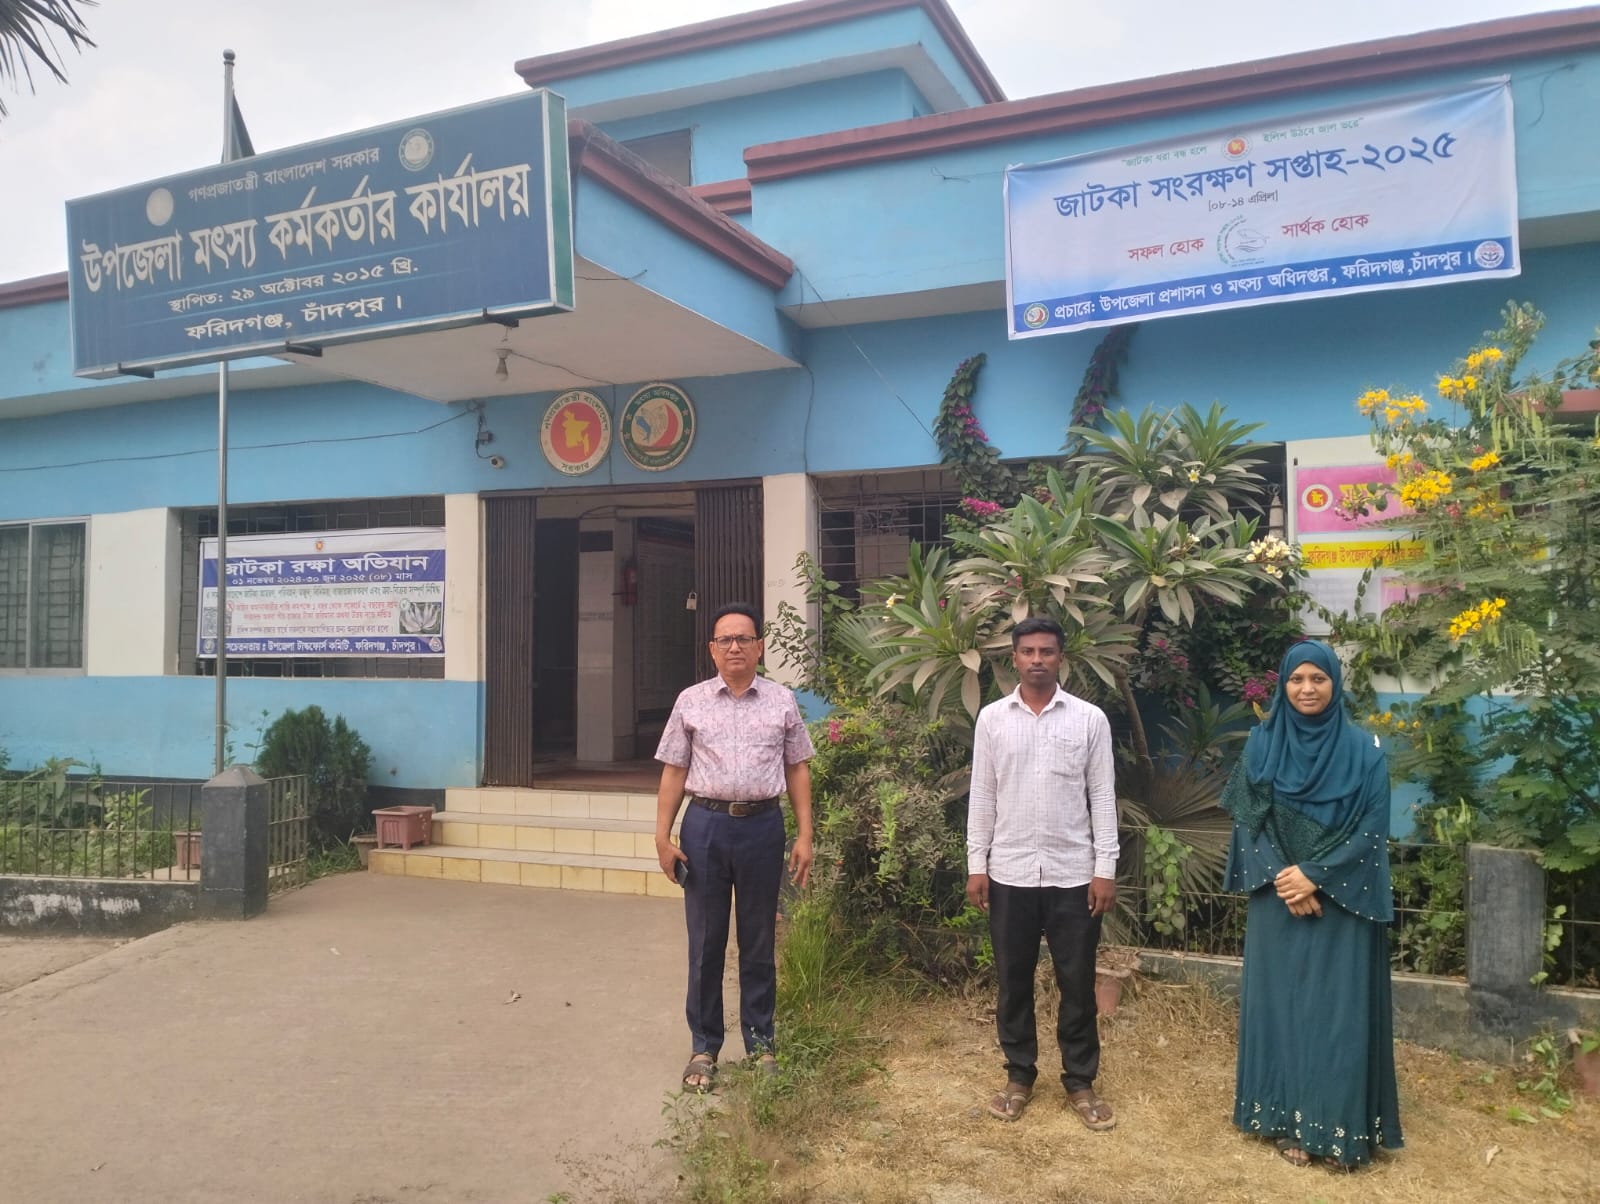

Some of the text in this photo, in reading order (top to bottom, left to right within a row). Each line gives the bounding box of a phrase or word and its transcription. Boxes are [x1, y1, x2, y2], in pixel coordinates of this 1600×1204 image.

[188, 147, 380, 202] গণপ্রজাতন্ত্রী বাংলাদেশ সরকার
[1053, 132, 1457, 217] জাটকা সংরক্ষণ সপ্তাহ-২০২৫
[80, 152, 532, 292] উপজেলা মৎস্য কর্মকর্তার কার্যালয়
[1128, 213, 1370, 262] সফল হোক সার্থক হোক
[231, 287, 255, 302] ২৯
[259, 273, 324, 296] অক্টোবর
[332, 264, 384, 285] ২০১৫
[1099, 291, 1155, 312] উপজেলা
[1158, 284, 1206, 304] প্রশাসন
[1211, 284, 1223, 296] ও
[1227, 276, 1263, 294] মৎস্য
[184, 312, 293, 340] ফরিদগঞ্জ,
[301, 296, 384, 321] চাঁদপুর
[225, 552, 430, 577] জাটকা রক্ষা অভিযান
[340, 573, 366, 582] ২০২৫
[394, 572, 414, 581] মাস
